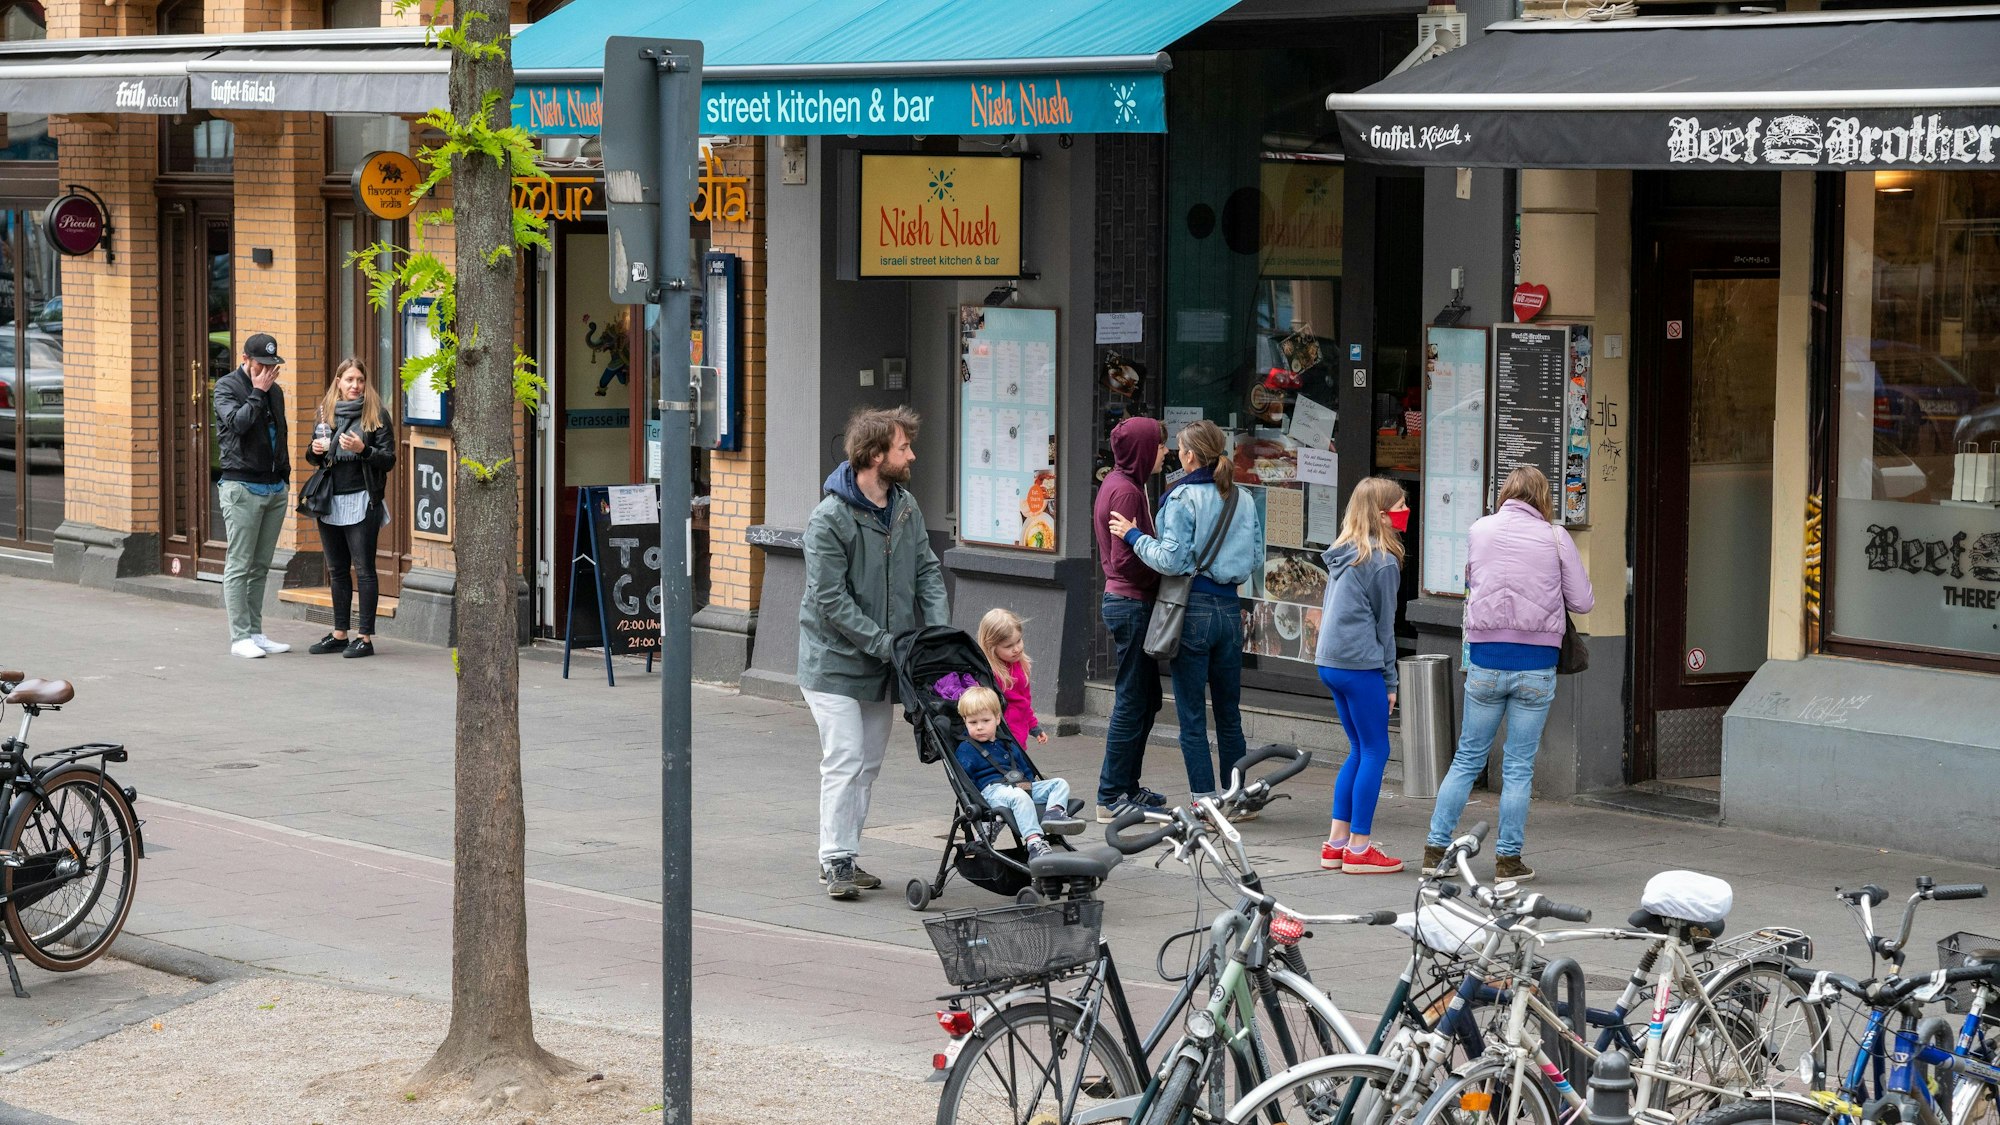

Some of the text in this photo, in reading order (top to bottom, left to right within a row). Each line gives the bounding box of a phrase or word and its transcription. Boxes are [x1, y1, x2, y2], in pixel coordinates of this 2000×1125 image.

[147, 95, 178, 107] KÖLSCH
[530, 87, 565, 128] Nish
[706, 87, 934, 123] street kitchen & bar
[970, 78, 1073, 127] Nish Nush
[1370, 123, 1463, 151] Gaffel Kölsch
[1667, 113, 2000, 164] Beef Brother
[788, 161, 797, 174] 14
[367, 184, 402, 196] flavour
[380, 197, 402, 209] india
[59, 214, 96, 228] Piccola
[879, 204, 1001, 248] Nish Nush
[880, 255, 1000, 266] israeli street kitchen & bar
[566, 412, 613, 427] Terrasse
[418, 463, 443, 491] To
[417, 498, 446, 530] Go
[608, 537, 661, 571] To
[1864, 524, 1967, 579] Beef
[613, 573, 661, 616] Go
[617, 620, 645, 631] 12:00
[628, 637, 655, 648] 21:00
